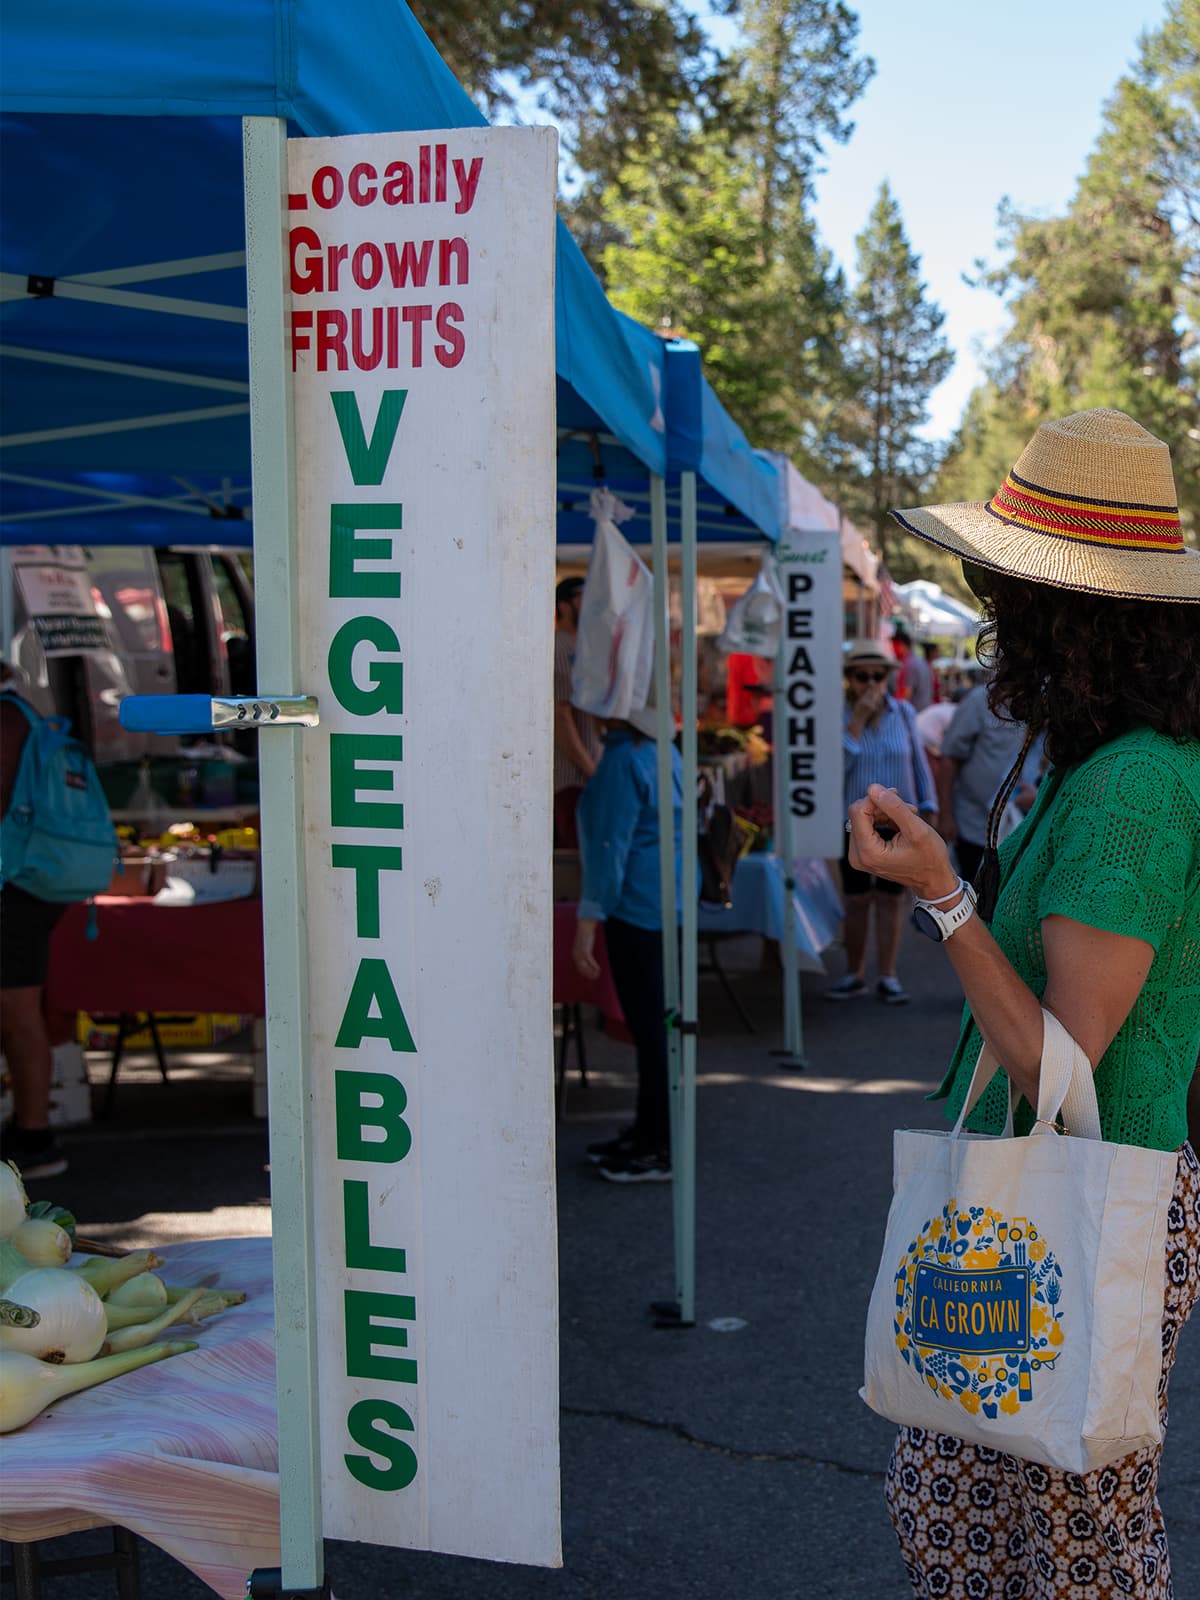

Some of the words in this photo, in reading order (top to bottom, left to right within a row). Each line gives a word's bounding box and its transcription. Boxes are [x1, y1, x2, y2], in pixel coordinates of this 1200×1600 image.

[289, 226, 470, 295] Grown
[291, 302, 466, 373] FRUITS
[786, 573, 817, 818] PEACHES
[327, 389, 418, 1492] VEGETABLES
[920, 1295, 940, 1330] CA
[945, 1299, 1020, 1336] GROWN
[932, 1276, 1003, 1294] CALIFORNIA
